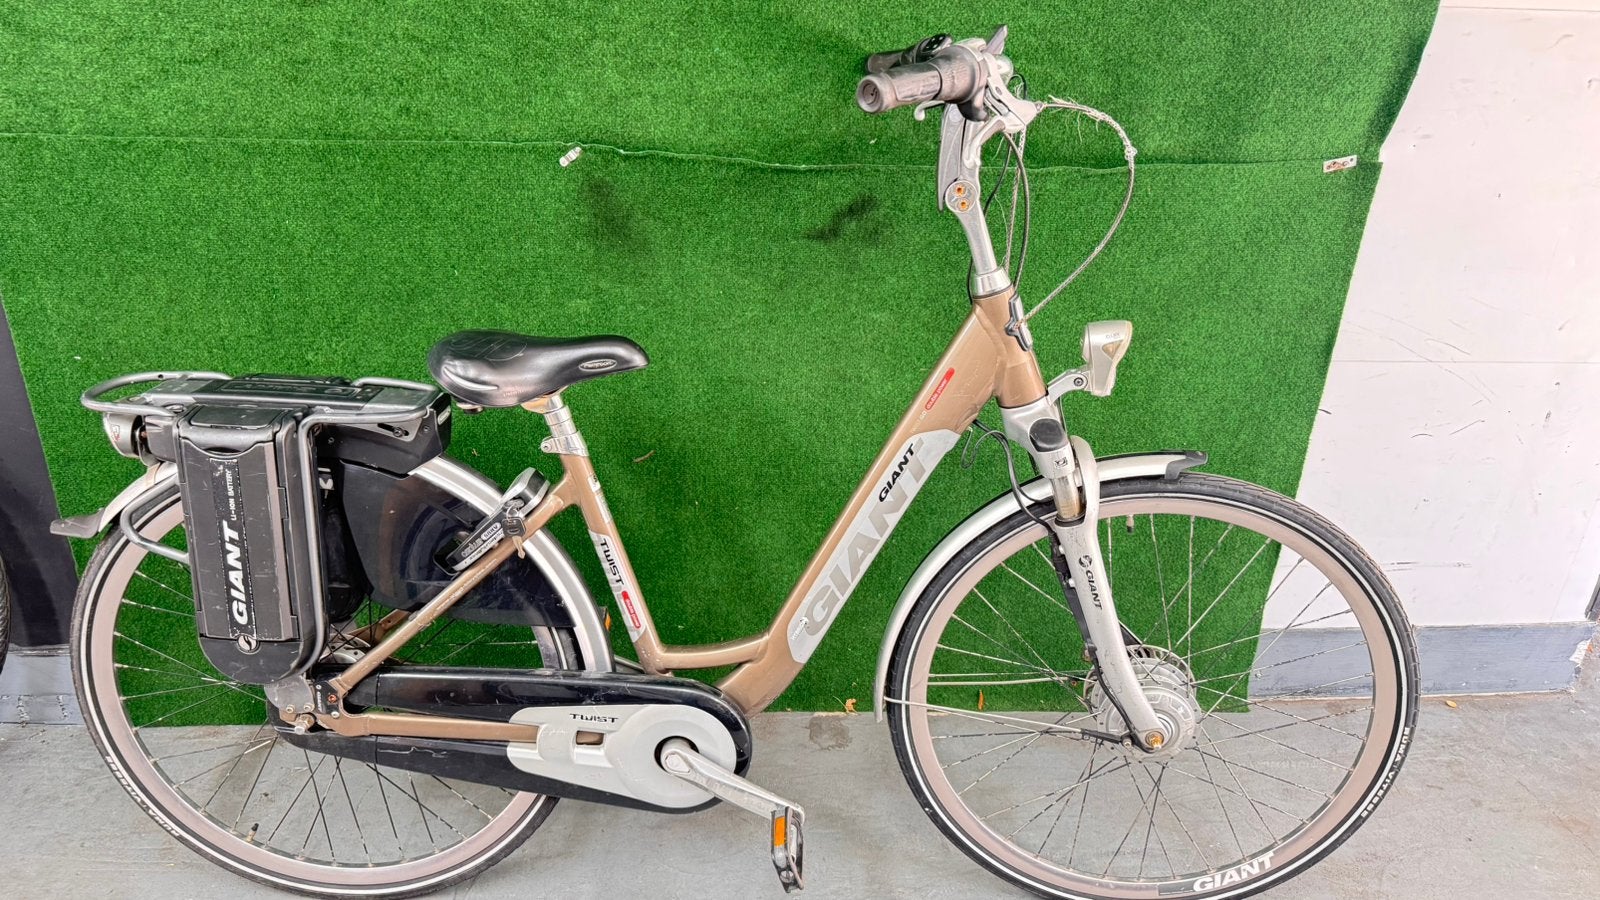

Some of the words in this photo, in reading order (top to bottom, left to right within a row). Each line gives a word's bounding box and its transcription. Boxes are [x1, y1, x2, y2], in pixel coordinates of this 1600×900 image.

[878, 443, 915, 502] GIANT
[804, 436, 926, 637] GIANT
[222, 520, 248, 625] GIANT
[601, 537, 624, 585] TWIST
[1086, 570, 1102, 610] GIANT
[570, 713, 619, 723] TWIST
[1193, 852, 1274, 892] GIANT
